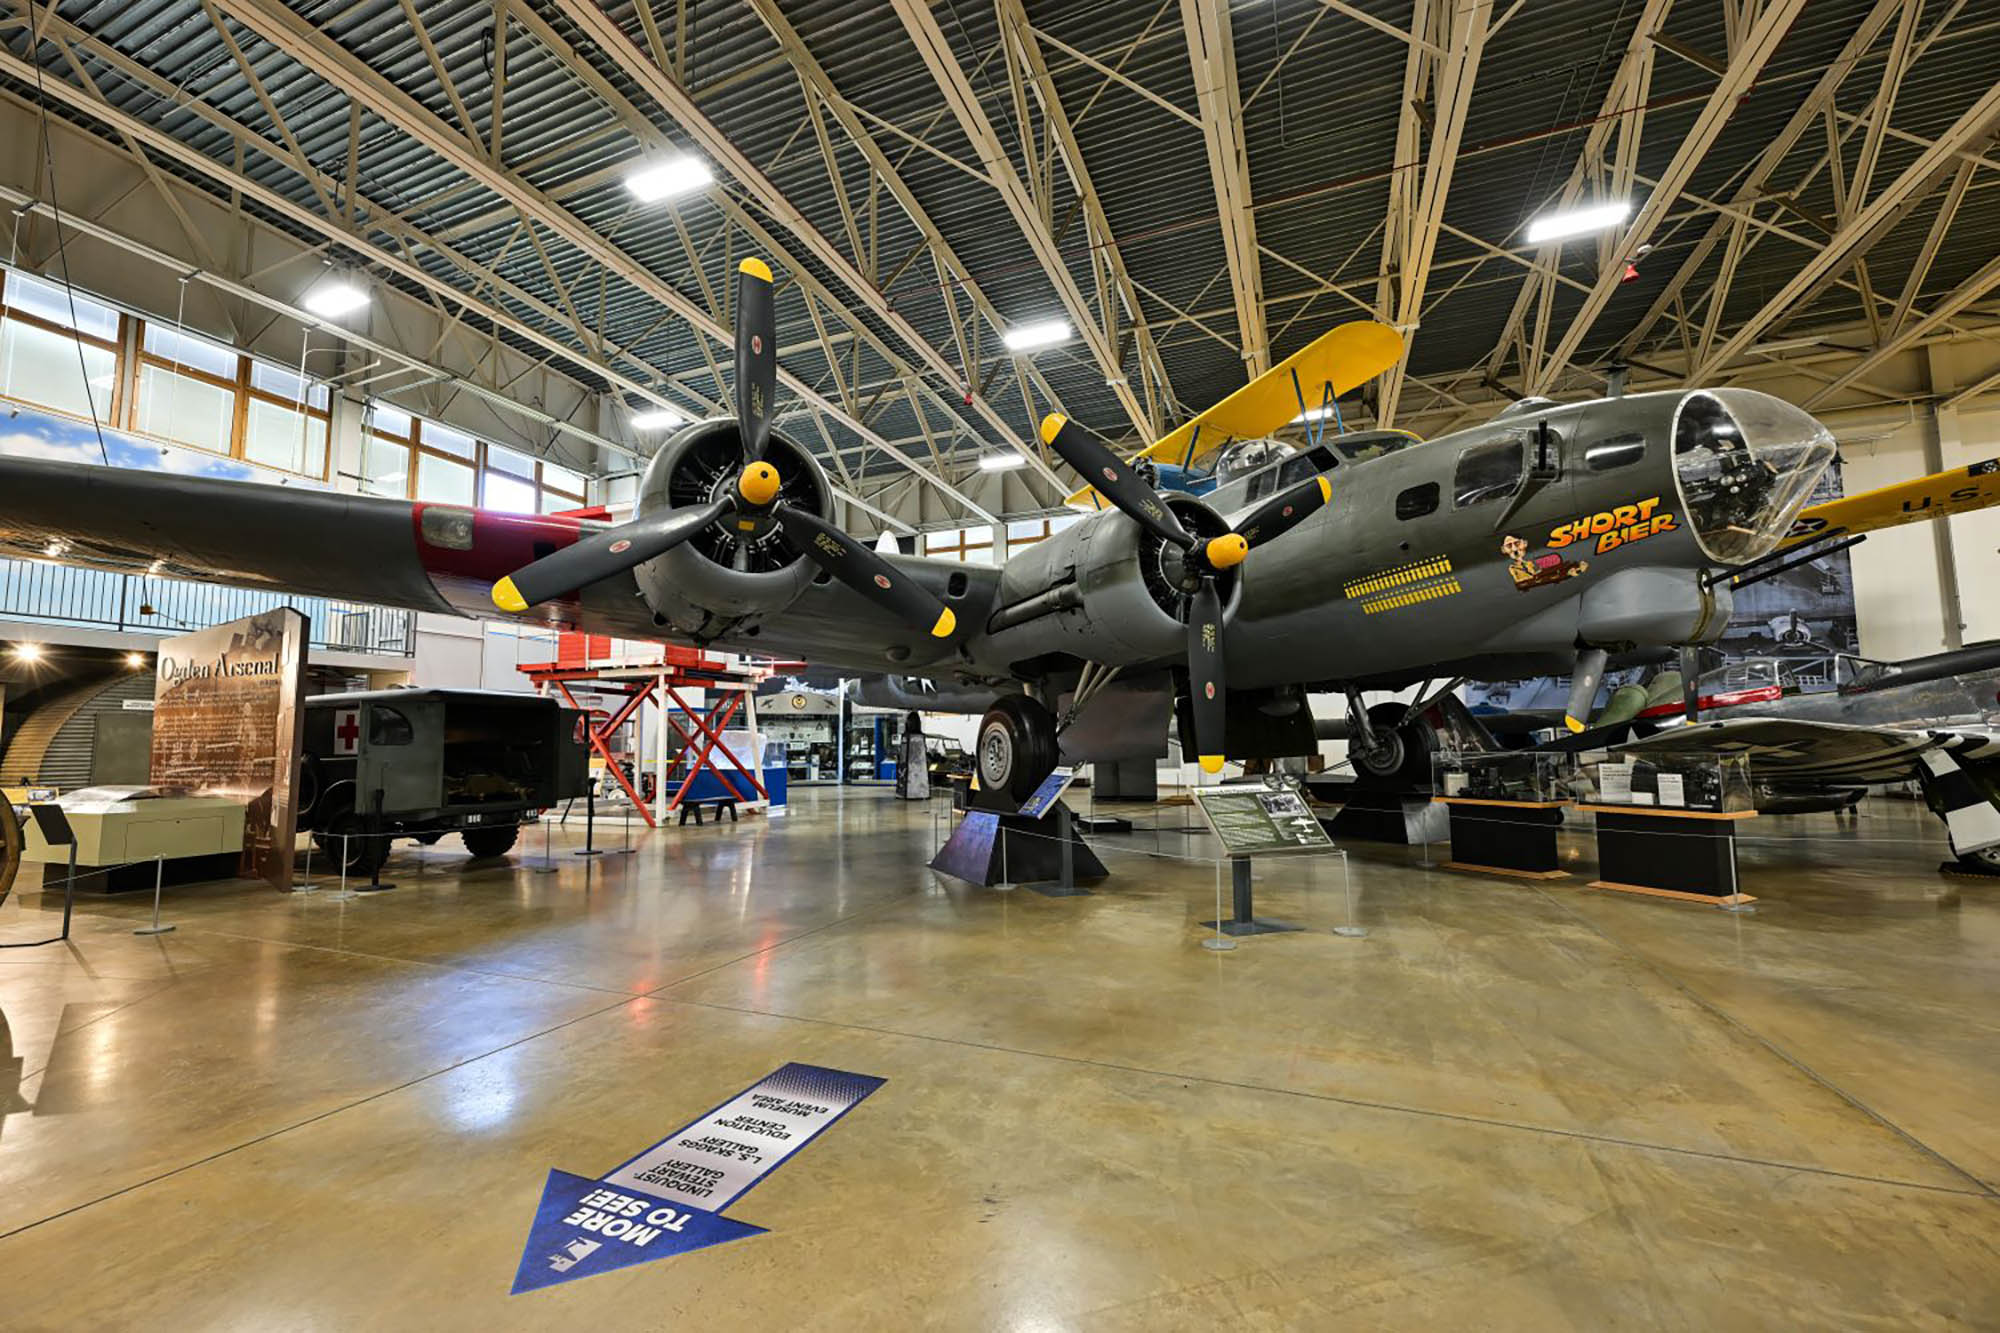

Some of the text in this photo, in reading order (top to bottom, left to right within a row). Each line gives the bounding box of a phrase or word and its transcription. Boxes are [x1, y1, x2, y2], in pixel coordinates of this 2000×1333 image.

[1546, 496, 1661, 548] SHORT
[1594, 513, 1681, 556] BIER
[161, 652, 280, 687] Ogden Arsenal
[752, 1093, 829, 1114] EVENT AREA
[752, 1101, 812, 1118] MUSEUM
[713, 1118, 793, 1141] EDUCATION
[734, 1115, 788, 1130] CENTER
[678, 1139, 763, 1165] L.S. SKAGGS
[698, 1135, 760, 1154] GALLERY
[648, 1165, 719, 1188] STEWART
[661, 1158, 726, 1179] GALLERY
[578, 1188, 693, 1232] TO SEE!
[562, 1207, 662, 1247] MORE
